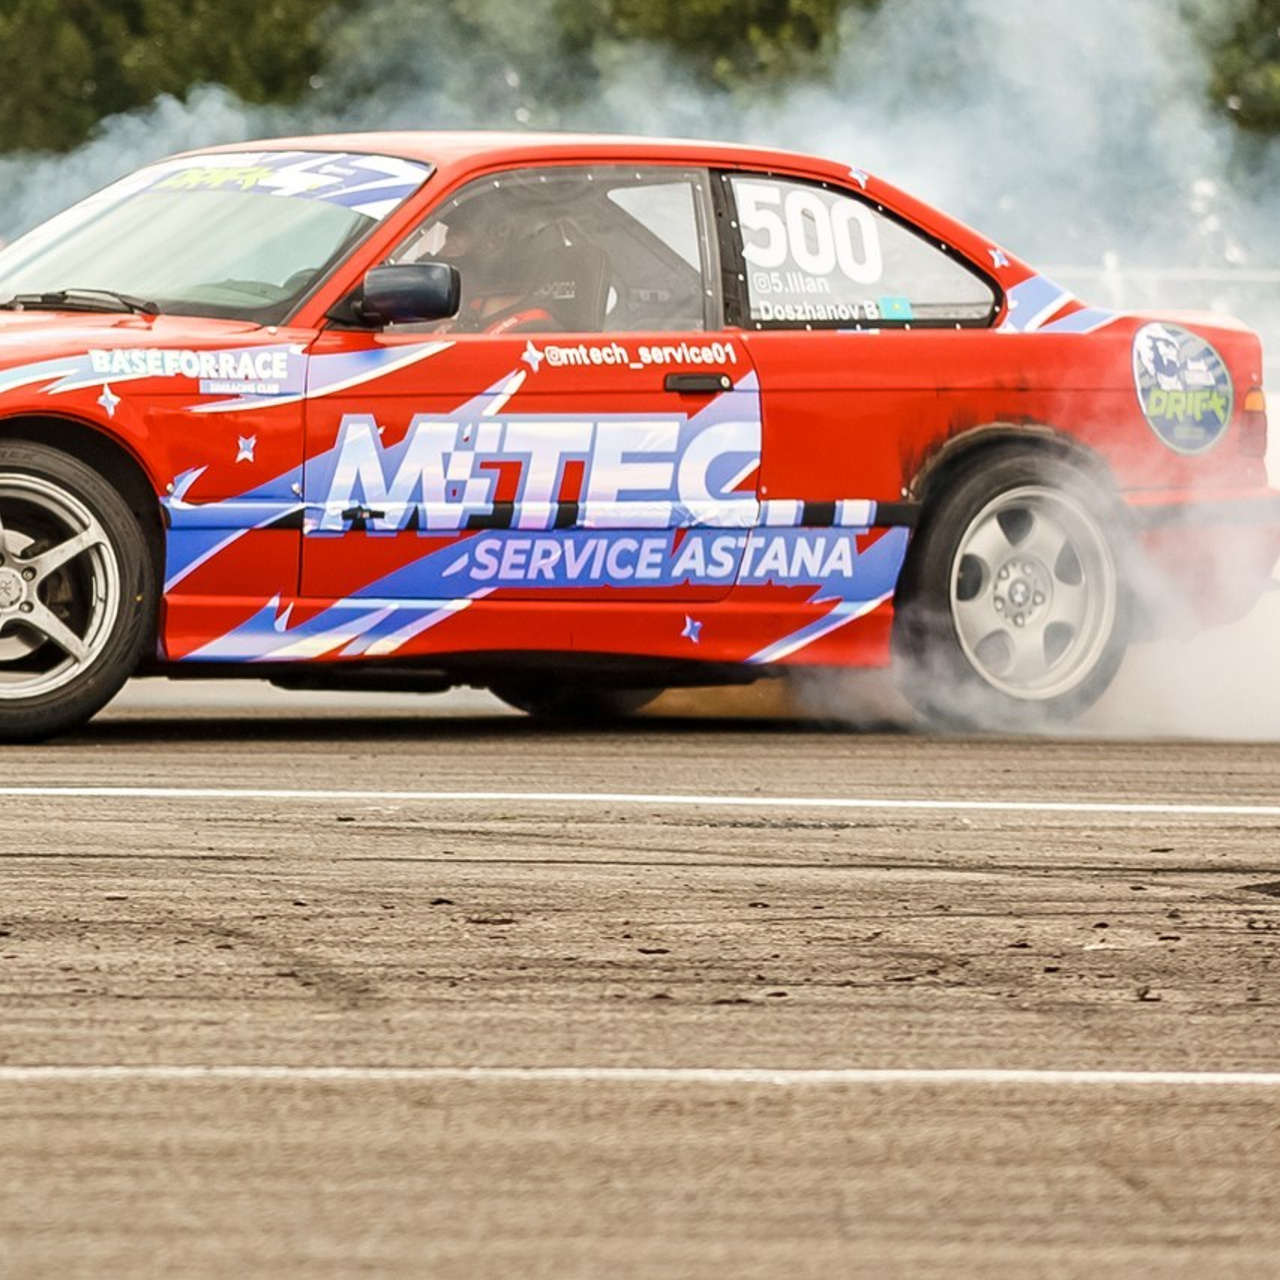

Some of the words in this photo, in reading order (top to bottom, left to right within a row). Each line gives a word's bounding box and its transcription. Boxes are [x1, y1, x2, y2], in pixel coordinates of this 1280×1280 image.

[736, 183, 883, 285] 500
[759, 300, 859, 321] Doszhanov
[863, 300, 879, 320] B
[1147, 387, 1226, 425] DRIFT
[470, 537, 667, 580] SERVICE
[671, 537, 854, 578] ASTANA
